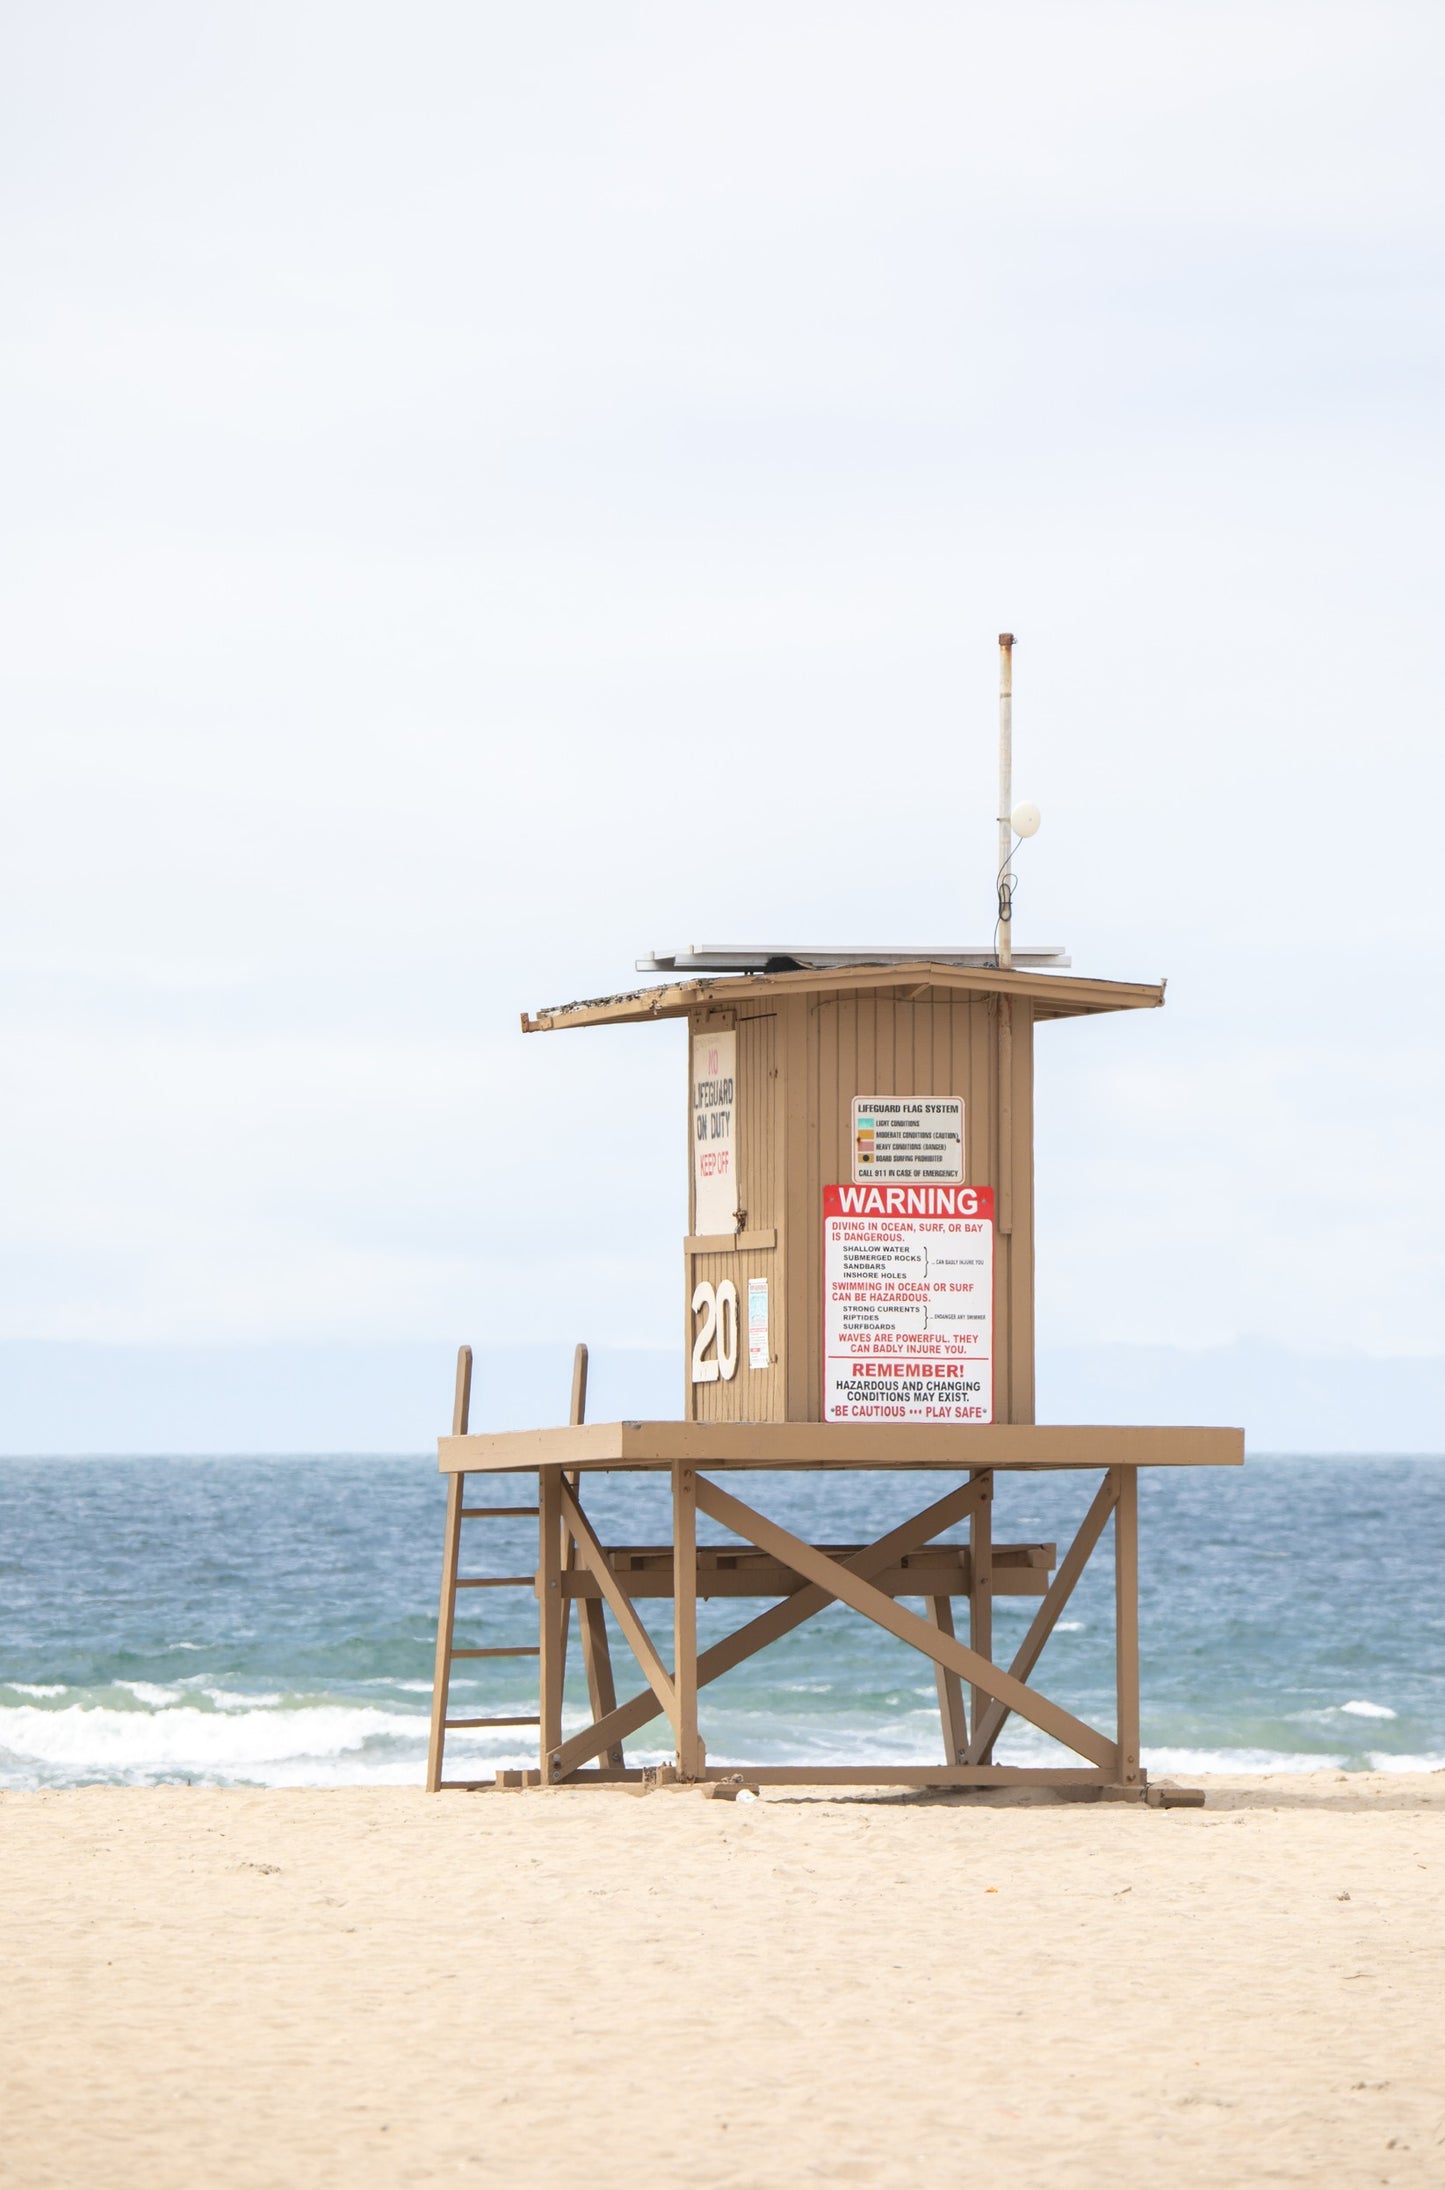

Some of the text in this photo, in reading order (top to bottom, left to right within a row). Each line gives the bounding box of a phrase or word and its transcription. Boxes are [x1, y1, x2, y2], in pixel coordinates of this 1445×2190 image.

[708, 1049, 718, 1075] NO
[694, 1078, 733, 1109] LIFEGUARD
[925, 1105, 959, 1113] SYSTEM
[697, 1111, 730, 1141] ON DUTY
[700, 1151, 729, 1176] KEEP OFF
[839, 1188, 978, 1215] WARNING
[832, 1222, 865, 1231] DIVING
[868, 1222, 877, 1231] IN
[882, 1222, 916, 1233] OCEAN,
[919, 1224, 946, 1233] SURF,
[832, 1232, 905, 1242] IS DANGEROUS.
[832, 1282, 882, 1291] SWIMMING
[885, 1282, 894, 1291] IN
[898, 1283, 930, 1291] OCEAN
[832, 1292, 931, 1302] CAN BE HAZARDOUS.
[692, 1280, 740, 1383] 20
[839, 1334, 979, 1343] WAVES ARE POWERFUL. THEY
[851, 1344, 967, 1354] CAN BADLY INJURE YOU.
[852, 1363, 964, 1377] REMEMBER!
[836, 1381, 980, 1391] HAZARDOUS AND CHANGING
[847, 1391, 969, 1402] CONDITIONS MAY EXIST.
[835, 1405, 982, 1418] BE CAUTIOUS PLAY SAFE
